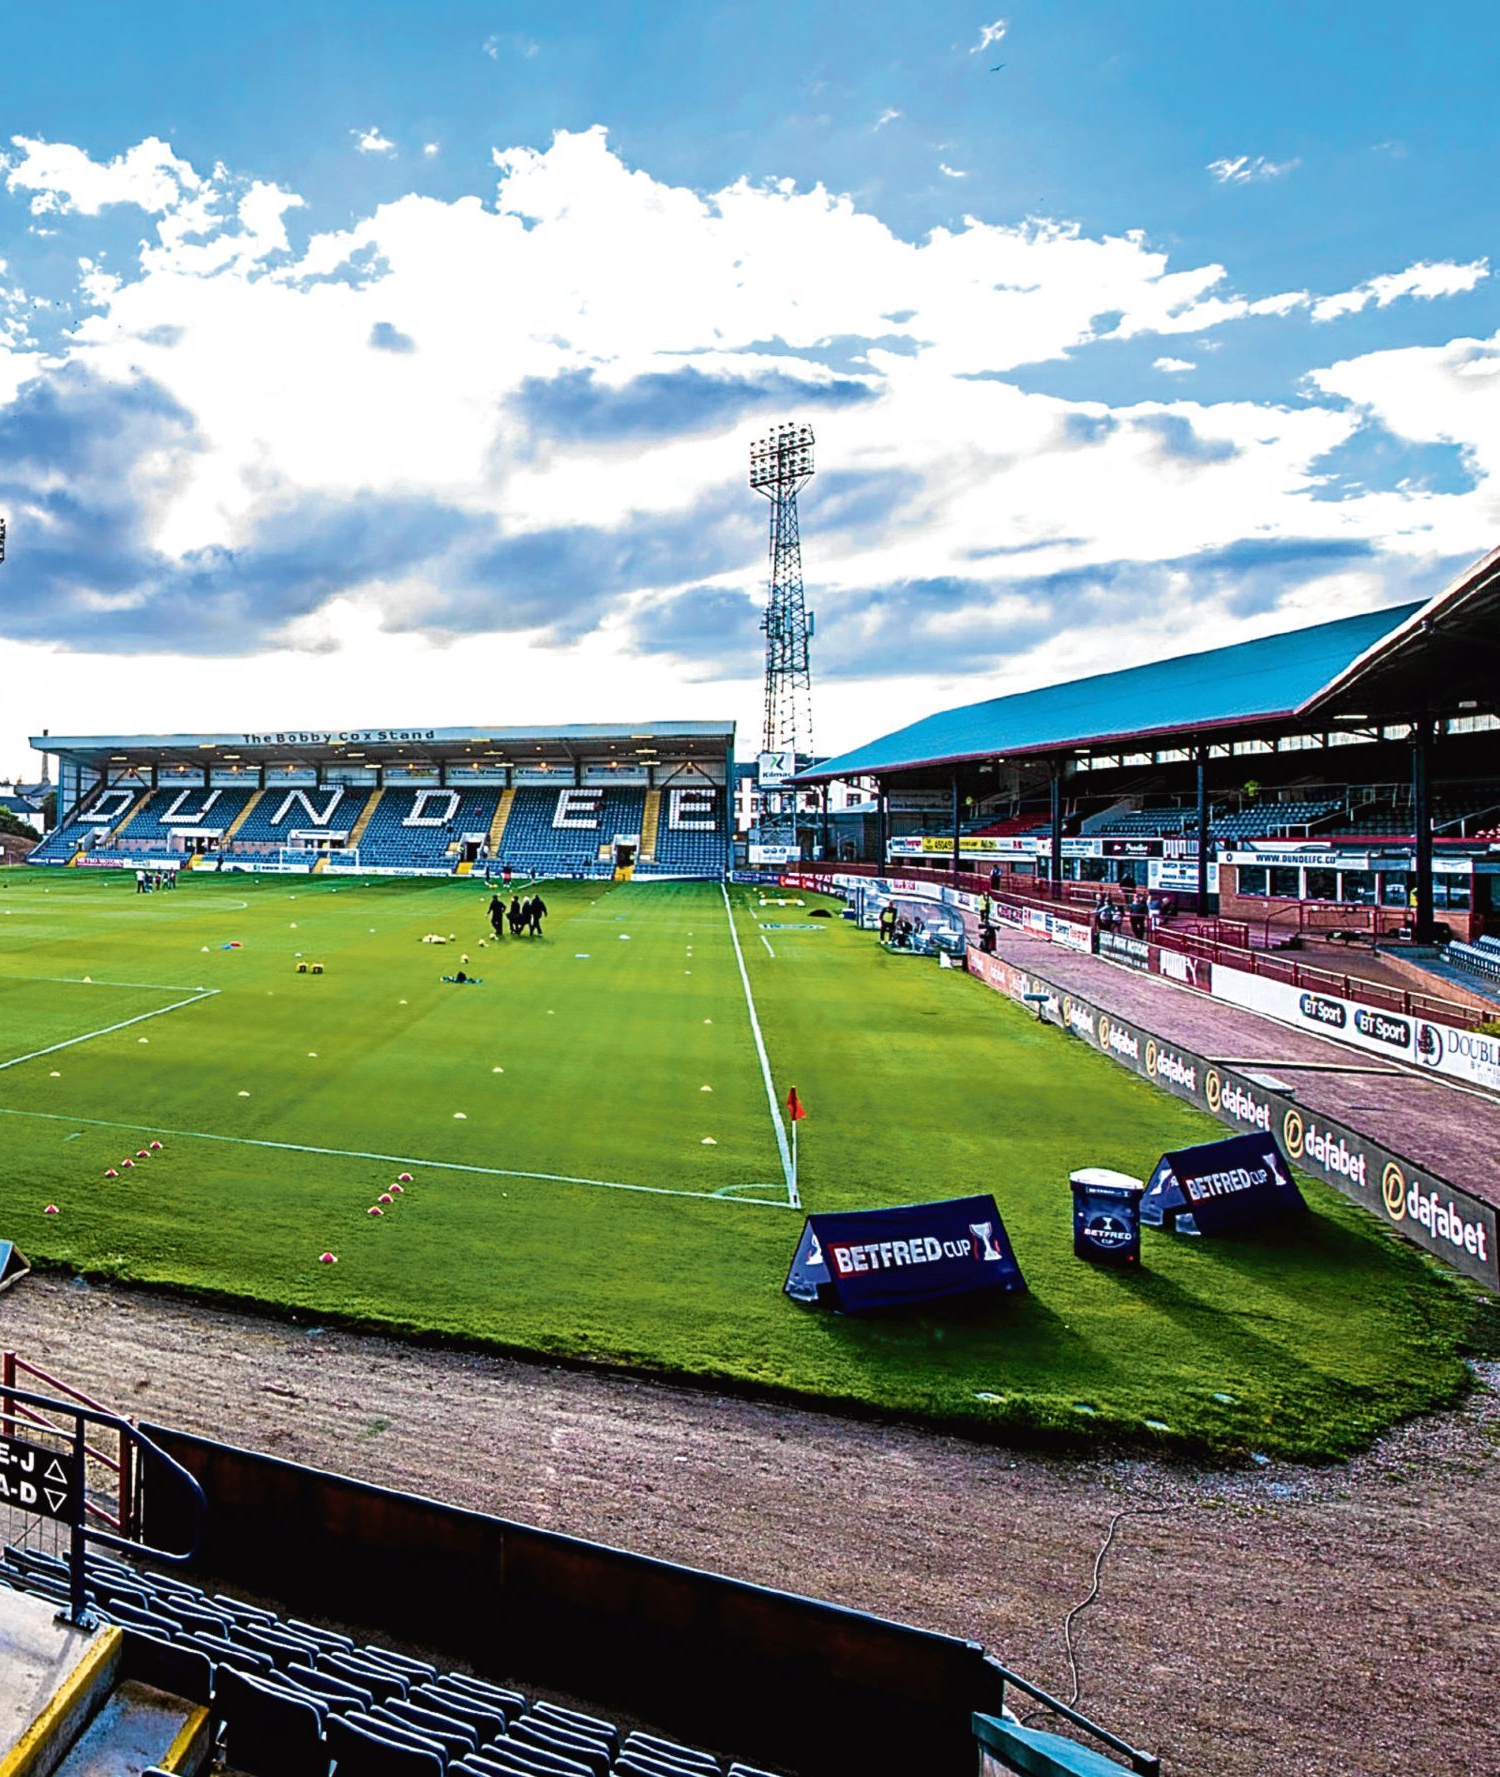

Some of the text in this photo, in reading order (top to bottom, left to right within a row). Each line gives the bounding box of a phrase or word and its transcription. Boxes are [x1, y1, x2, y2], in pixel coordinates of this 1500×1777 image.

[243, 730, 435, 744] The Bobby Cox Stand
[77, 787, 717, 831] DUNDEE
[1304, 998, 1342, 1023] BT Sport
[1360, 1013, 1406, 1043] BT Sport
[1156, 1053, 1197, 1091] dafabet
[1221, 1086, 1271, 1131] dafabet
[1305, 1124, 1367, 1187] dafabet
[1186, 1168, 1269, 1200] BETFRED CUP
[1084, 1228, 1132, 1240] BETFRED
[1407, 1181, 1488, 1262] dafabet
[834, 1237, 971, 1273] BETFRED CUP
